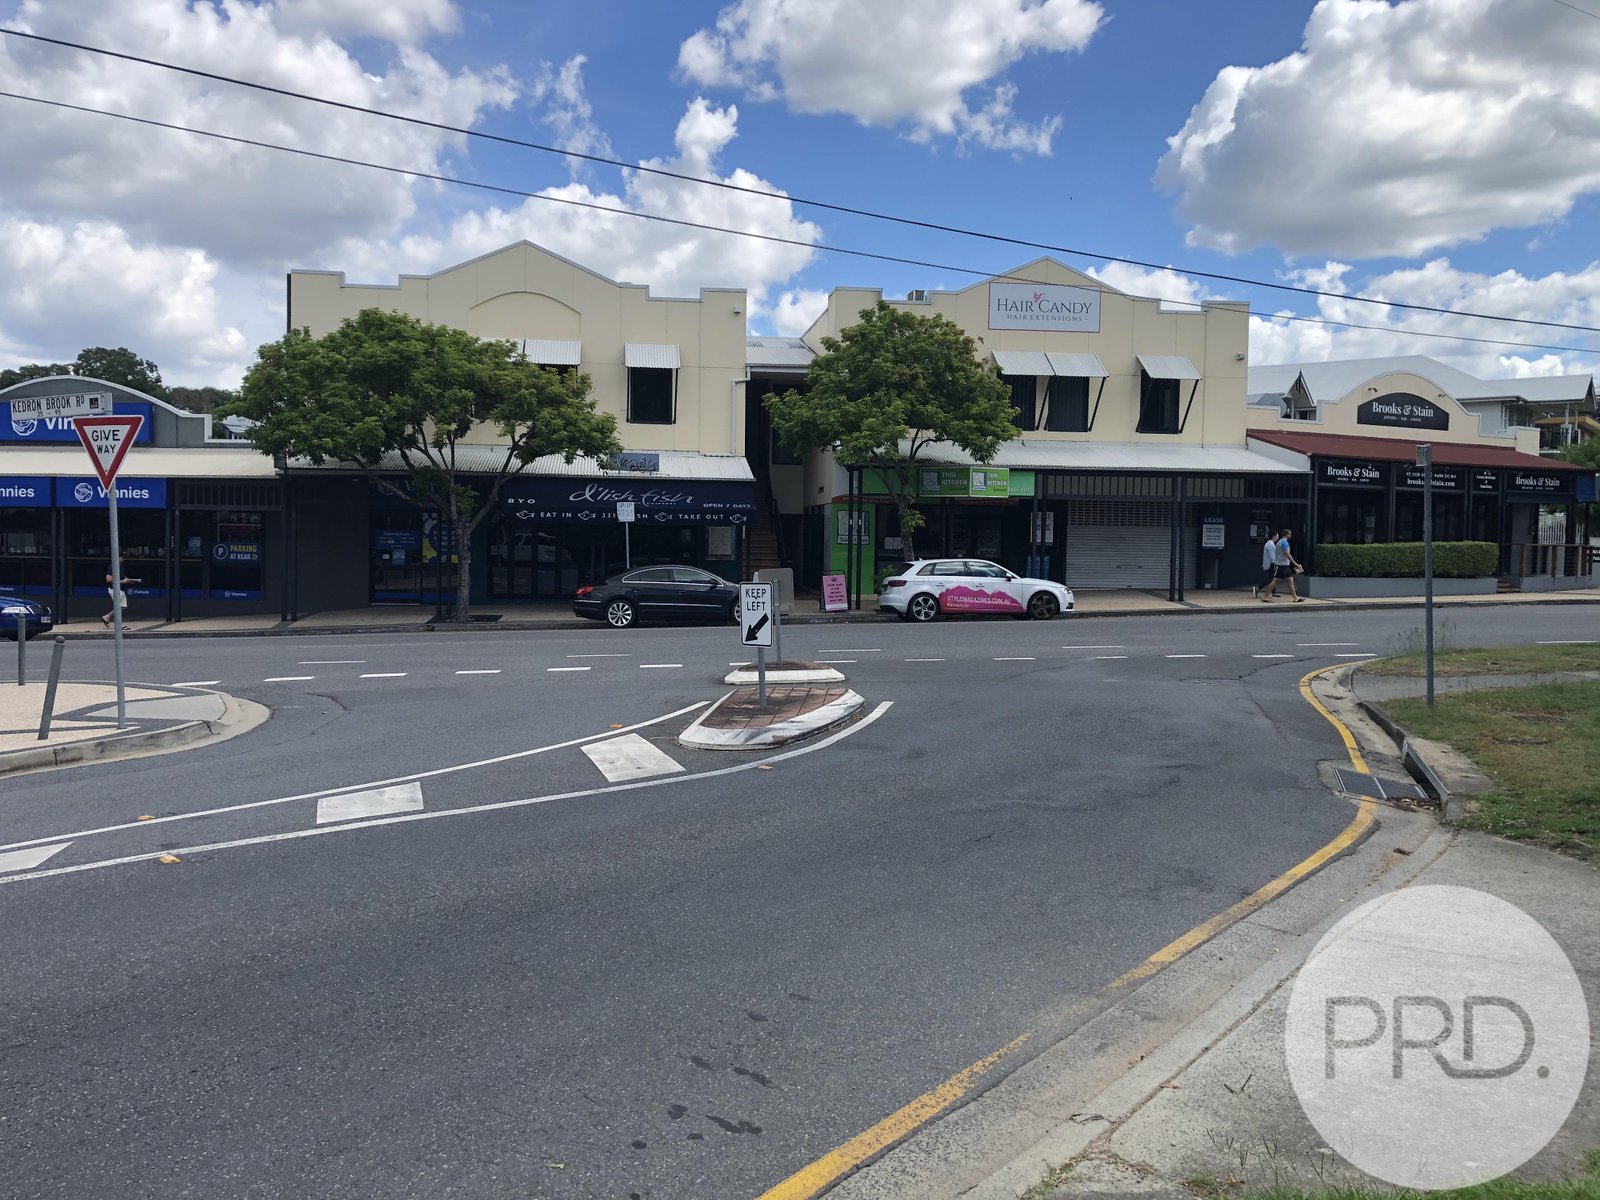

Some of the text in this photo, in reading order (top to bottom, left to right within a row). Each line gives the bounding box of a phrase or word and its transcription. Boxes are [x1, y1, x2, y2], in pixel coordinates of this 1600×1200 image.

[997, 298, 1093, 314] HAIR CANDY
[1030, 314, 1082, 322] EXTENSIONS
[12, 399, 41, 413] KEDRON
[46, 397, 72, 410] BROOK
[1372, 401, 1434, 417] Brooks & Stain
[91, 429, 120, 442] GIVE
[97, 444, 117, 454] WAY
[1327, 466, 1380, 478] Brooks & Stain
[1516, 476, 1560, 486] Brooks & Stain
[0, 485, 35, 498] nnies
[97, 486, 149, 499] Vnnies
[218, 547, 224, 555] P
[745, 588, 767, 598] KEEP
[746, 601, 766, 611] LEFT
